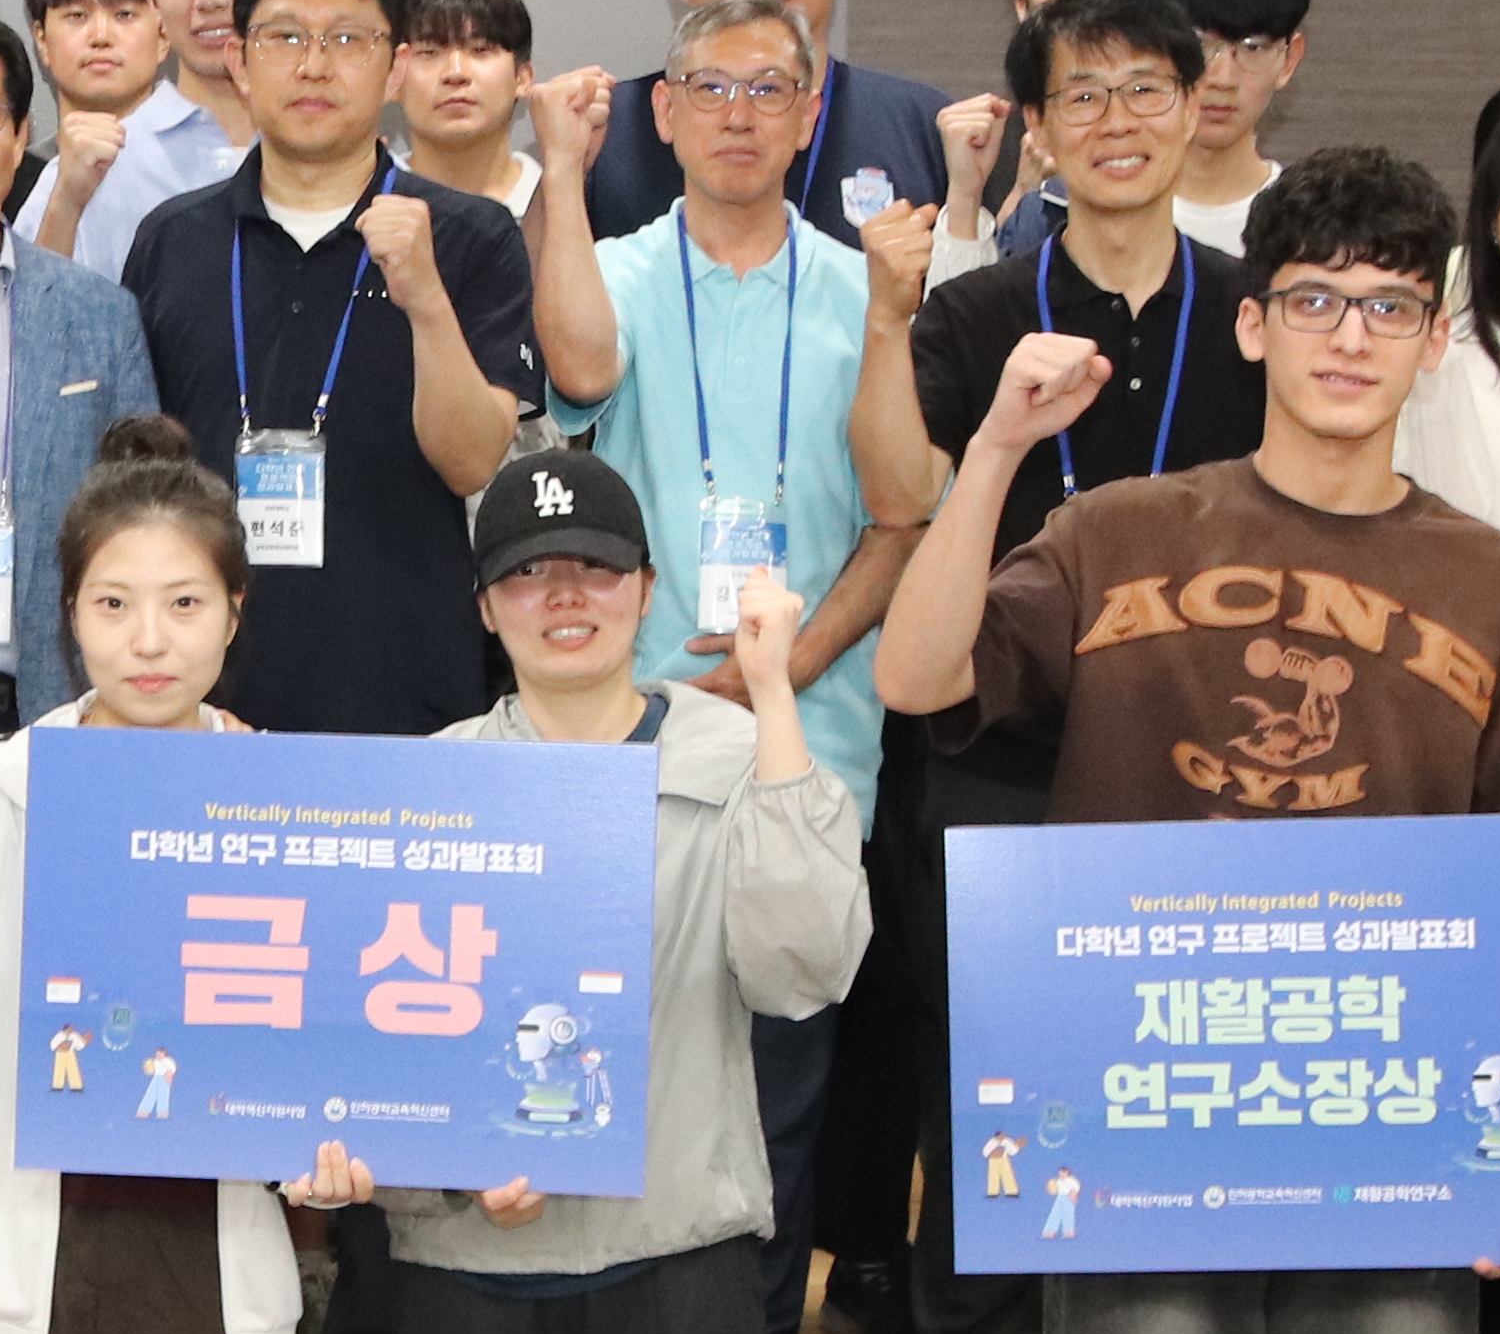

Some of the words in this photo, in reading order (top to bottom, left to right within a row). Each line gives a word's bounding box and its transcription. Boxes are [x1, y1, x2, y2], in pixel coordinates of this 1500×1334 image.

[532, 471, 575, 517] LA
[1075, 565, 1497, 728] ACNE
[1172, 742, 1370, 811] GYM
[205, 803, 291, 825] Vertically
[296, 806, 391, 828] Integrated
[401, 809, 473, 831] Projects
[131, 830, 213, 863] 다학년
[221, 833, 277, 865] 연구
[283, 836, 395, 868] 프로젝트
[403, 840, 543, 874] 성과발표회
[1130, 893, 1217, 914] Vertically
[1223, 891, 1319, 915] Integrated
[1329, 891, 1403, 913] Projects
[1057, 925, 1141, 956] 다학년
[1148, 924, 1205, 955] 연구
[1213, 922, 1326, 953] 프로젝트
[1333, 918, 1475, 951] 성과발표회
[181, 895, 309, 1028] 금
[360, 903, 498, 1036] 상
[1135, 975, 1406, 1045] 재활공학
[1104, 1058, 1442, 1128] 연구소장상
[1355, 1185, 1452, 1202] 재활공학연구소
